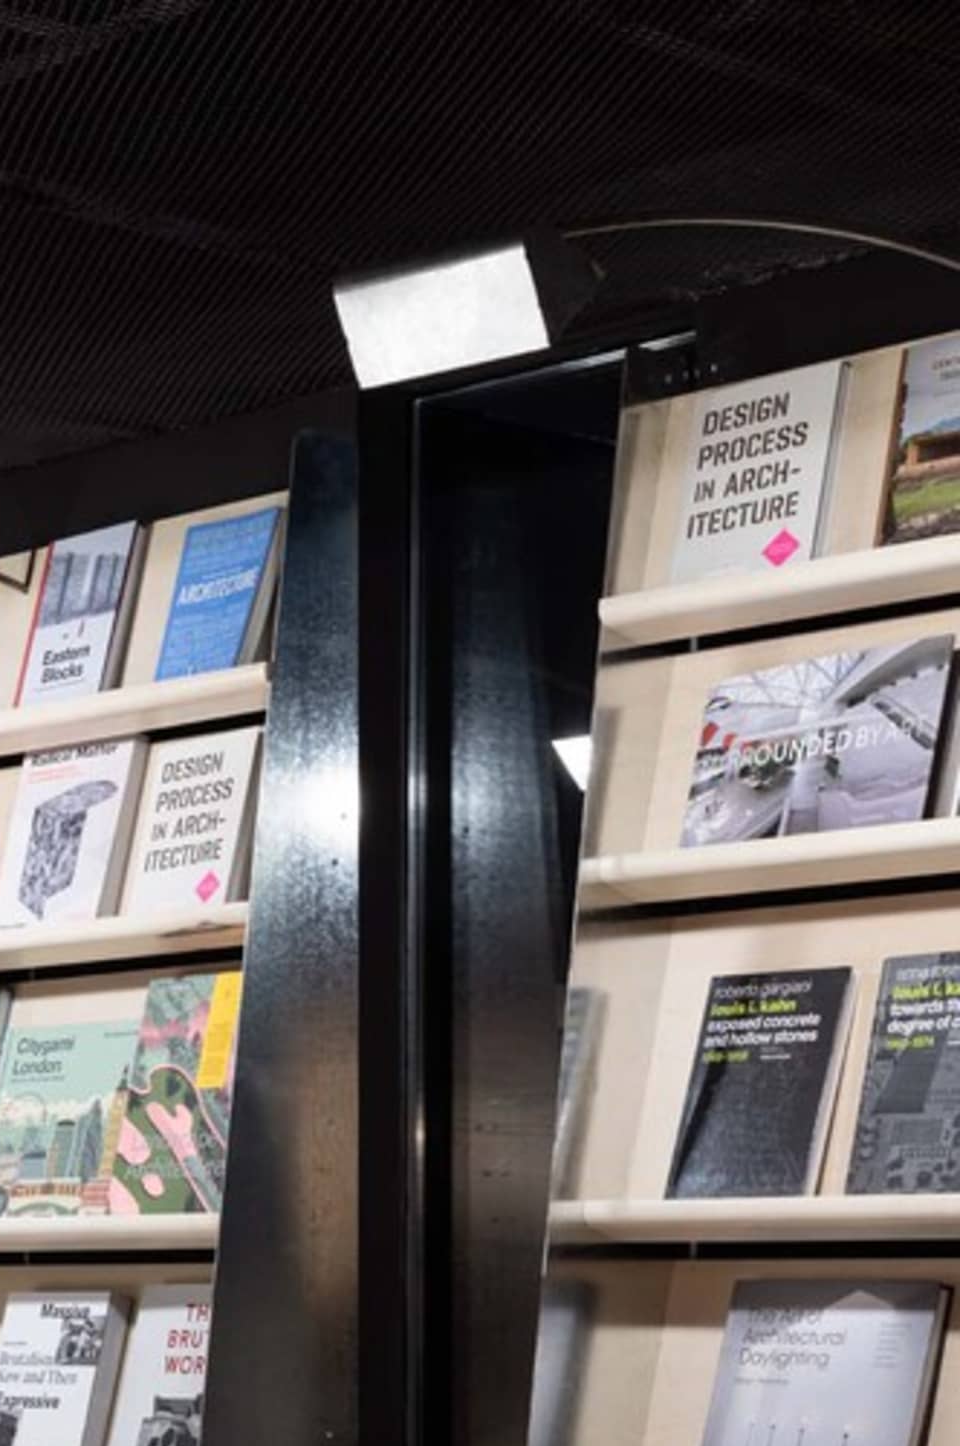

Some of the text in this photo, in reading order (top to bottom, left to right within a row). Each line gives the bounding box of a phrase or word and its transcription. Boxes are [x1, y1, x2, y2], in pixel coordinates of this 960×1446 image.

[701, 391, 790, 437] DESIGN
[697, 421, 809, 470] PROCESS
[693, 459, 802, 504] IN ARCH-
[686, 490, 800, 540] ITECTURE
[42, 644, 91, 666] Eastern
[41, 663, 83, 684] Blocks
[160, 751, 225, 785] DESIGN
[155, 778, 235, 814] PROCESS
[151, 812, 227, 842] IN ARCH-
[143, 838, 224, 873] ITECTURE
[11, 1059, 62, 1076] London
